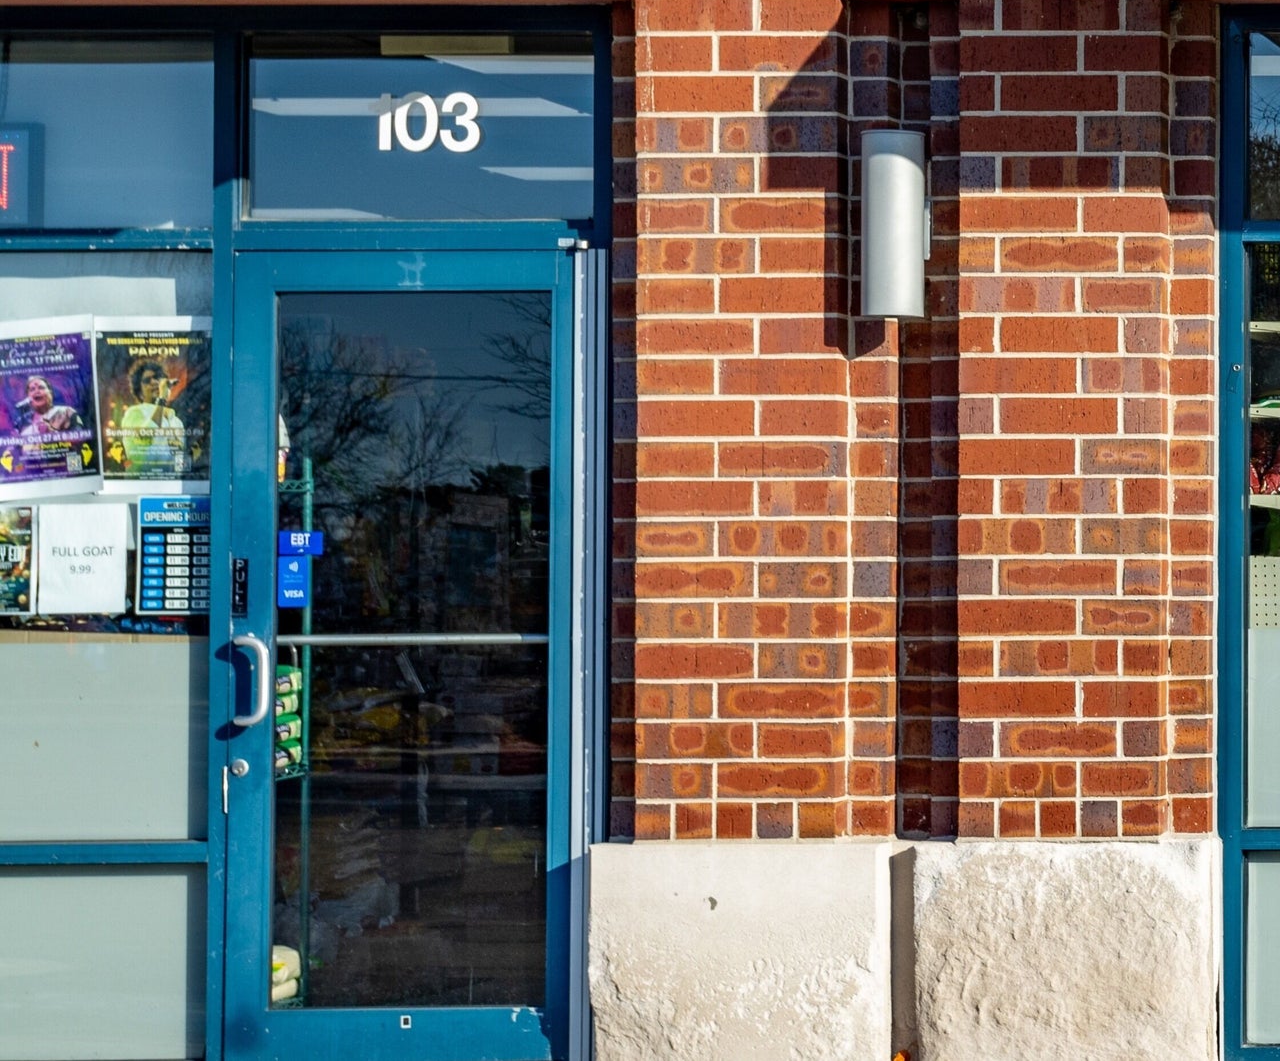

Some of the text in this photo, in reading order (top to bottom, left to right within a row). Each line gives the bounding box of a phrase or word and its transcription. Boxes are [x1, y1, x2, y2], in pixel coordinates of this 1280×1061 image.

[368, 91, 480, 152] 103
[129, 347, 180, 356] PAPON
[144, 511, 209, 522] OPENING HOUR
[290, 533, 311, 546] EBT
[52, 546, 115, 557] FULL GOAT
[283, 590, 304, 598] VISA
